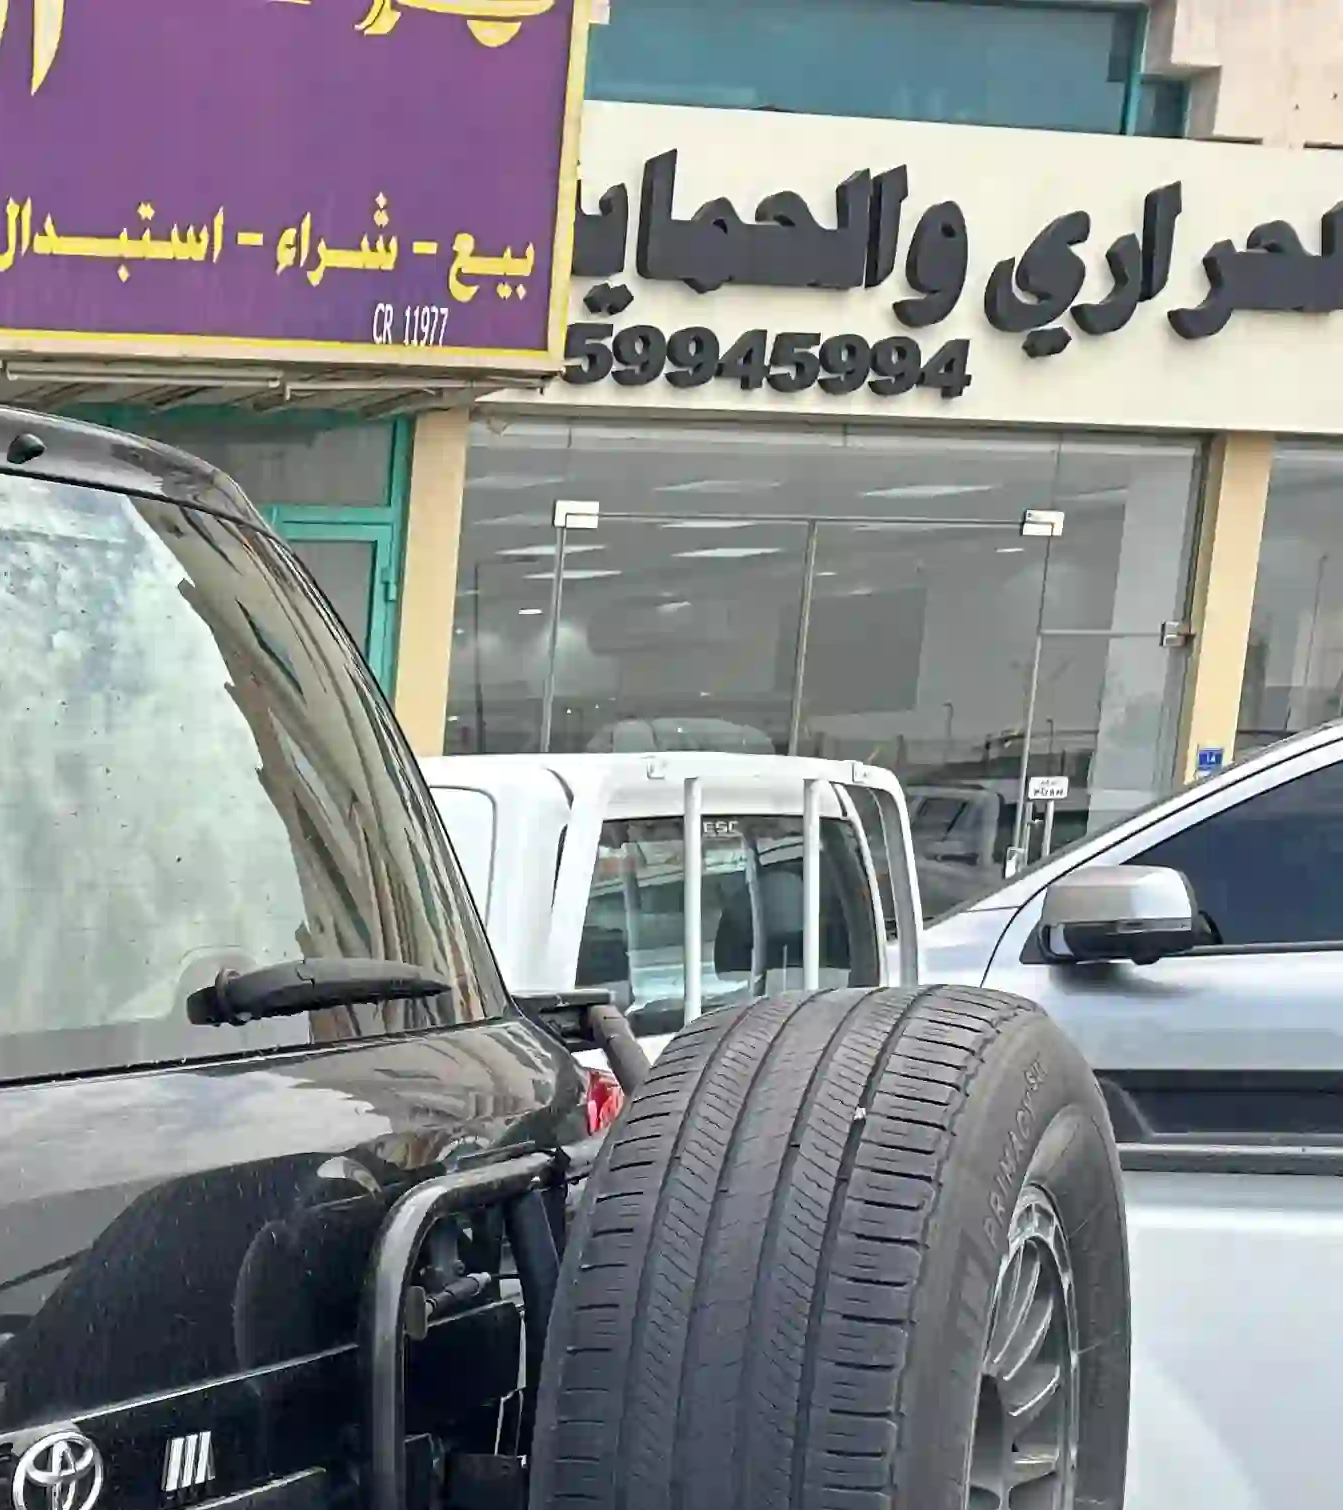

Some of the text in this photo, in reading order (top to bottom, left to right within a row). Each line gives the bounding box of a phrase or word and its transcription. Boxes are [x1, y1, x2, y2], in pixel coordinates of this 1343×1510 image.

[275, 192, 398, 287] شراء
[448, 232, 536, 302] بيع
[571, 148, 1343, 358] لحراري والحماي
[372, 303, 450, 347] CR 11977
[562, 322, 972, 399] 59945994
